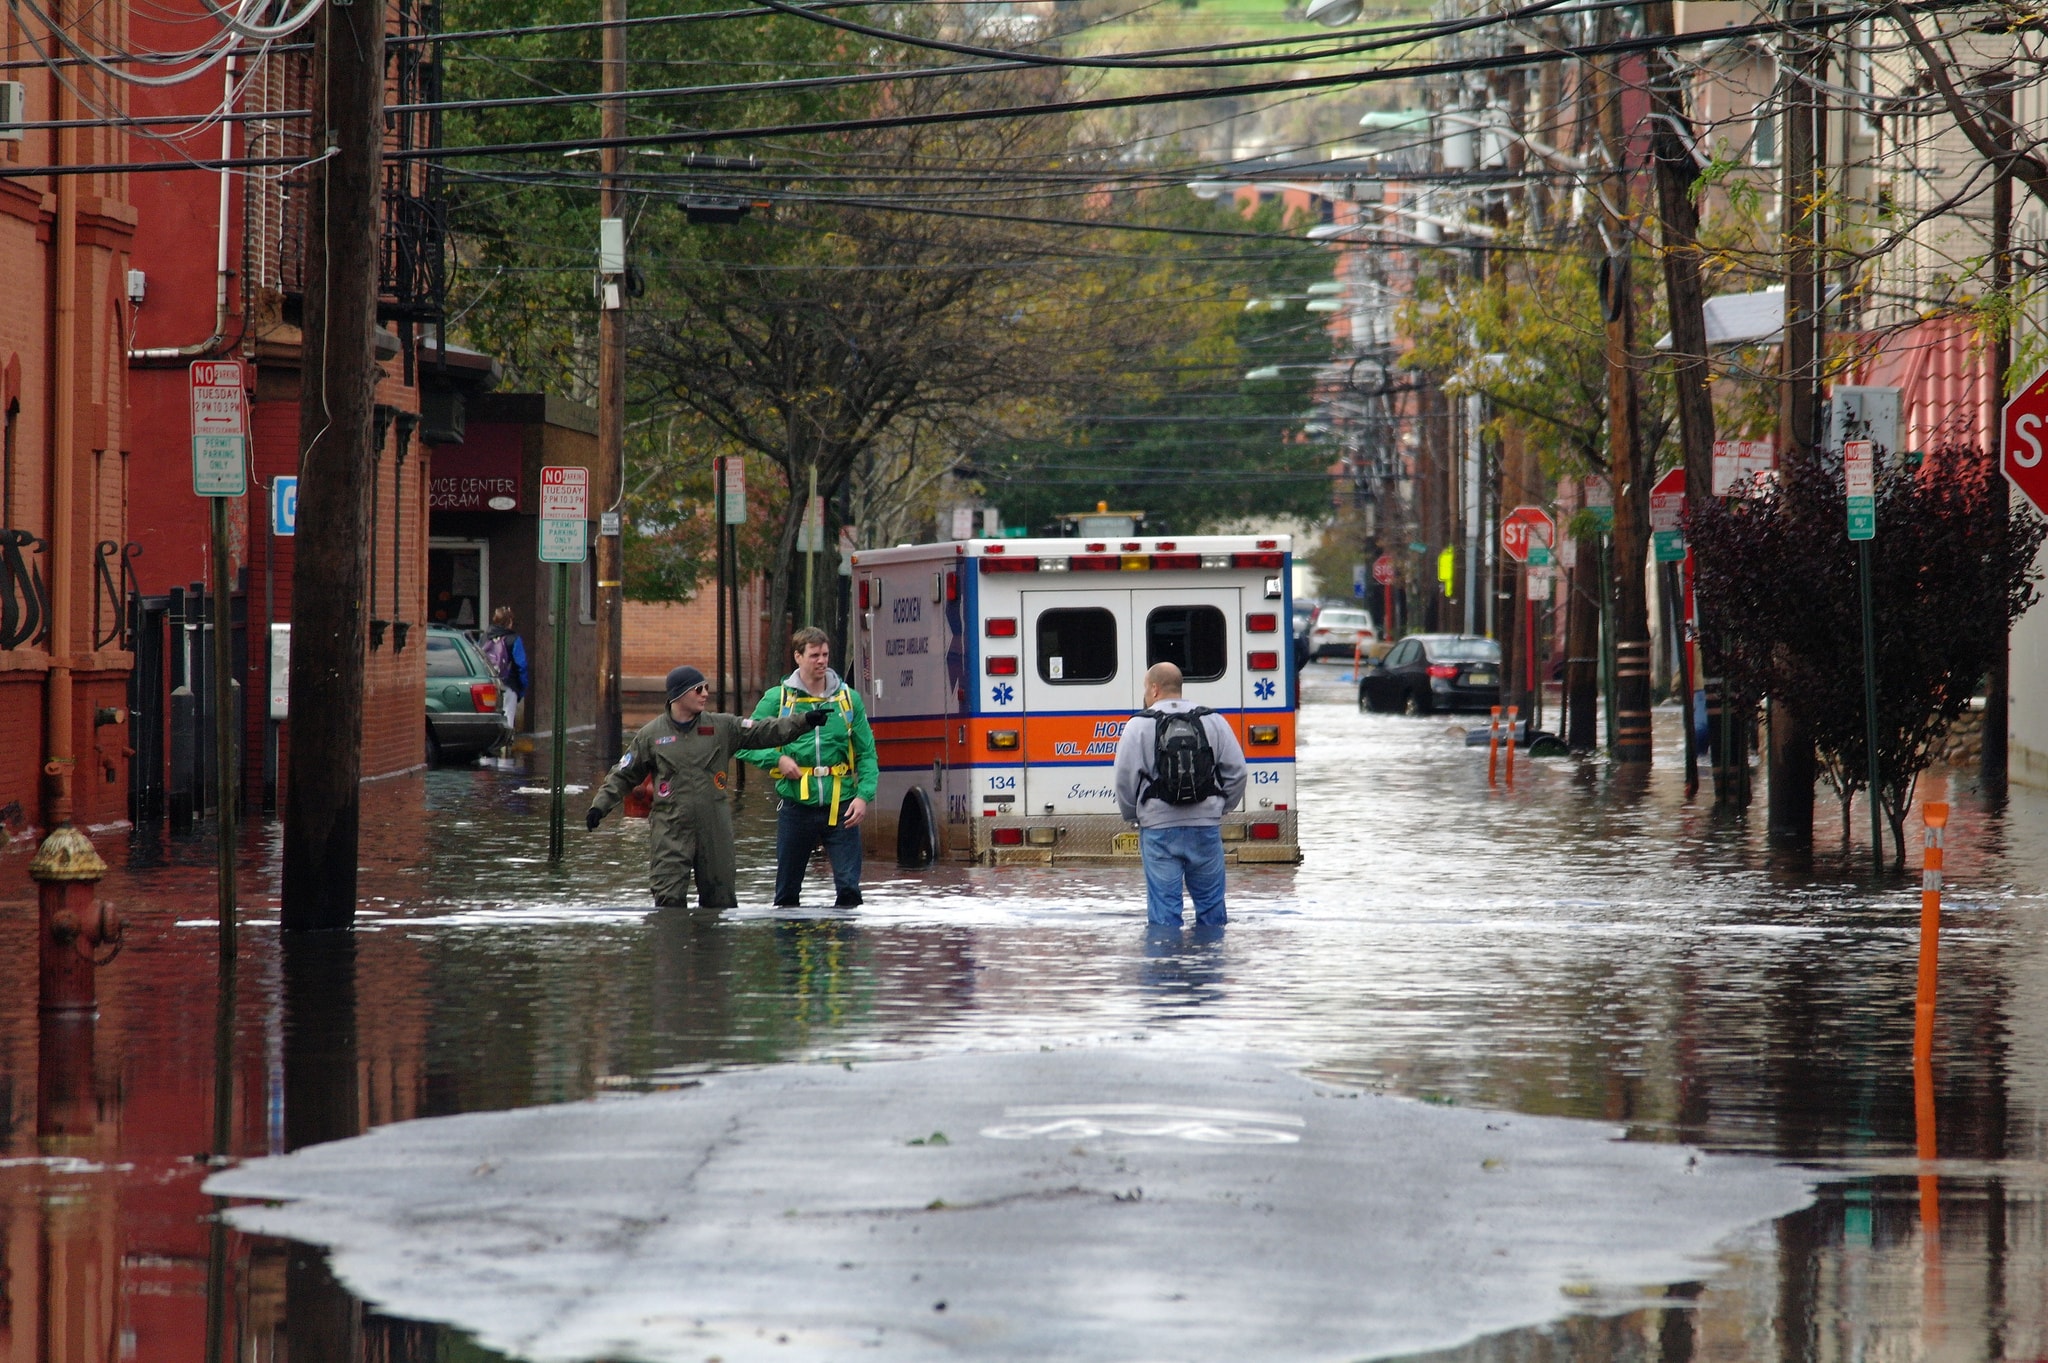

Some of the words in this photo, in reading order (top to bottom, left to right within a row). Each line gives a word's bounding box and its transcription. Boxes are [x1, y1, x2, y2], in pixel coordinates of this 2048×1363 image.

[195, 365, 214, 385] NO
[215, 369, 240, 381] PARKING
[198, 388, 238, 400] TUESDAY
[194, 401, 200, 413] 2
[201, 401, 212, 412] PM
[214, 401, 222, 413] TO
[224, 401, 229, 413] 3
[230, 401, 241, 413] PM
[205, 438, 232, 449] PERMIT
[2013, 413, 2048, 468] S
[202, 449, 236, 460] PARKING
[209, 460, 229, 470] ONLY
[545, 469, 563, 484] NO
[563, 473, 585, 481] PARKING
[460, 478, 516, 493] CENTER
[546, 486, 583, 495] TUESDAY
[543, 495, 548, 504] 2
[550, 495, 559, 503] PM
[560, 495, 568, 504] TO
[575, 495, 584, 504] PM
[551, 520, 575, 529] PERMIT
[548, 528, 578, 537] PARKING
[553, 536, 571, 545] ONLY
[893, 597, 921, 624] HOBOKEN
[886, 638, 906, 656] VOLUNTEER
[906, 636, 929, 655] AMBULANCE
[901, 670, 914, 687] CORPS
[988, 776, 1016, 790] 134
[1252, 771, 1279, 785] 134
